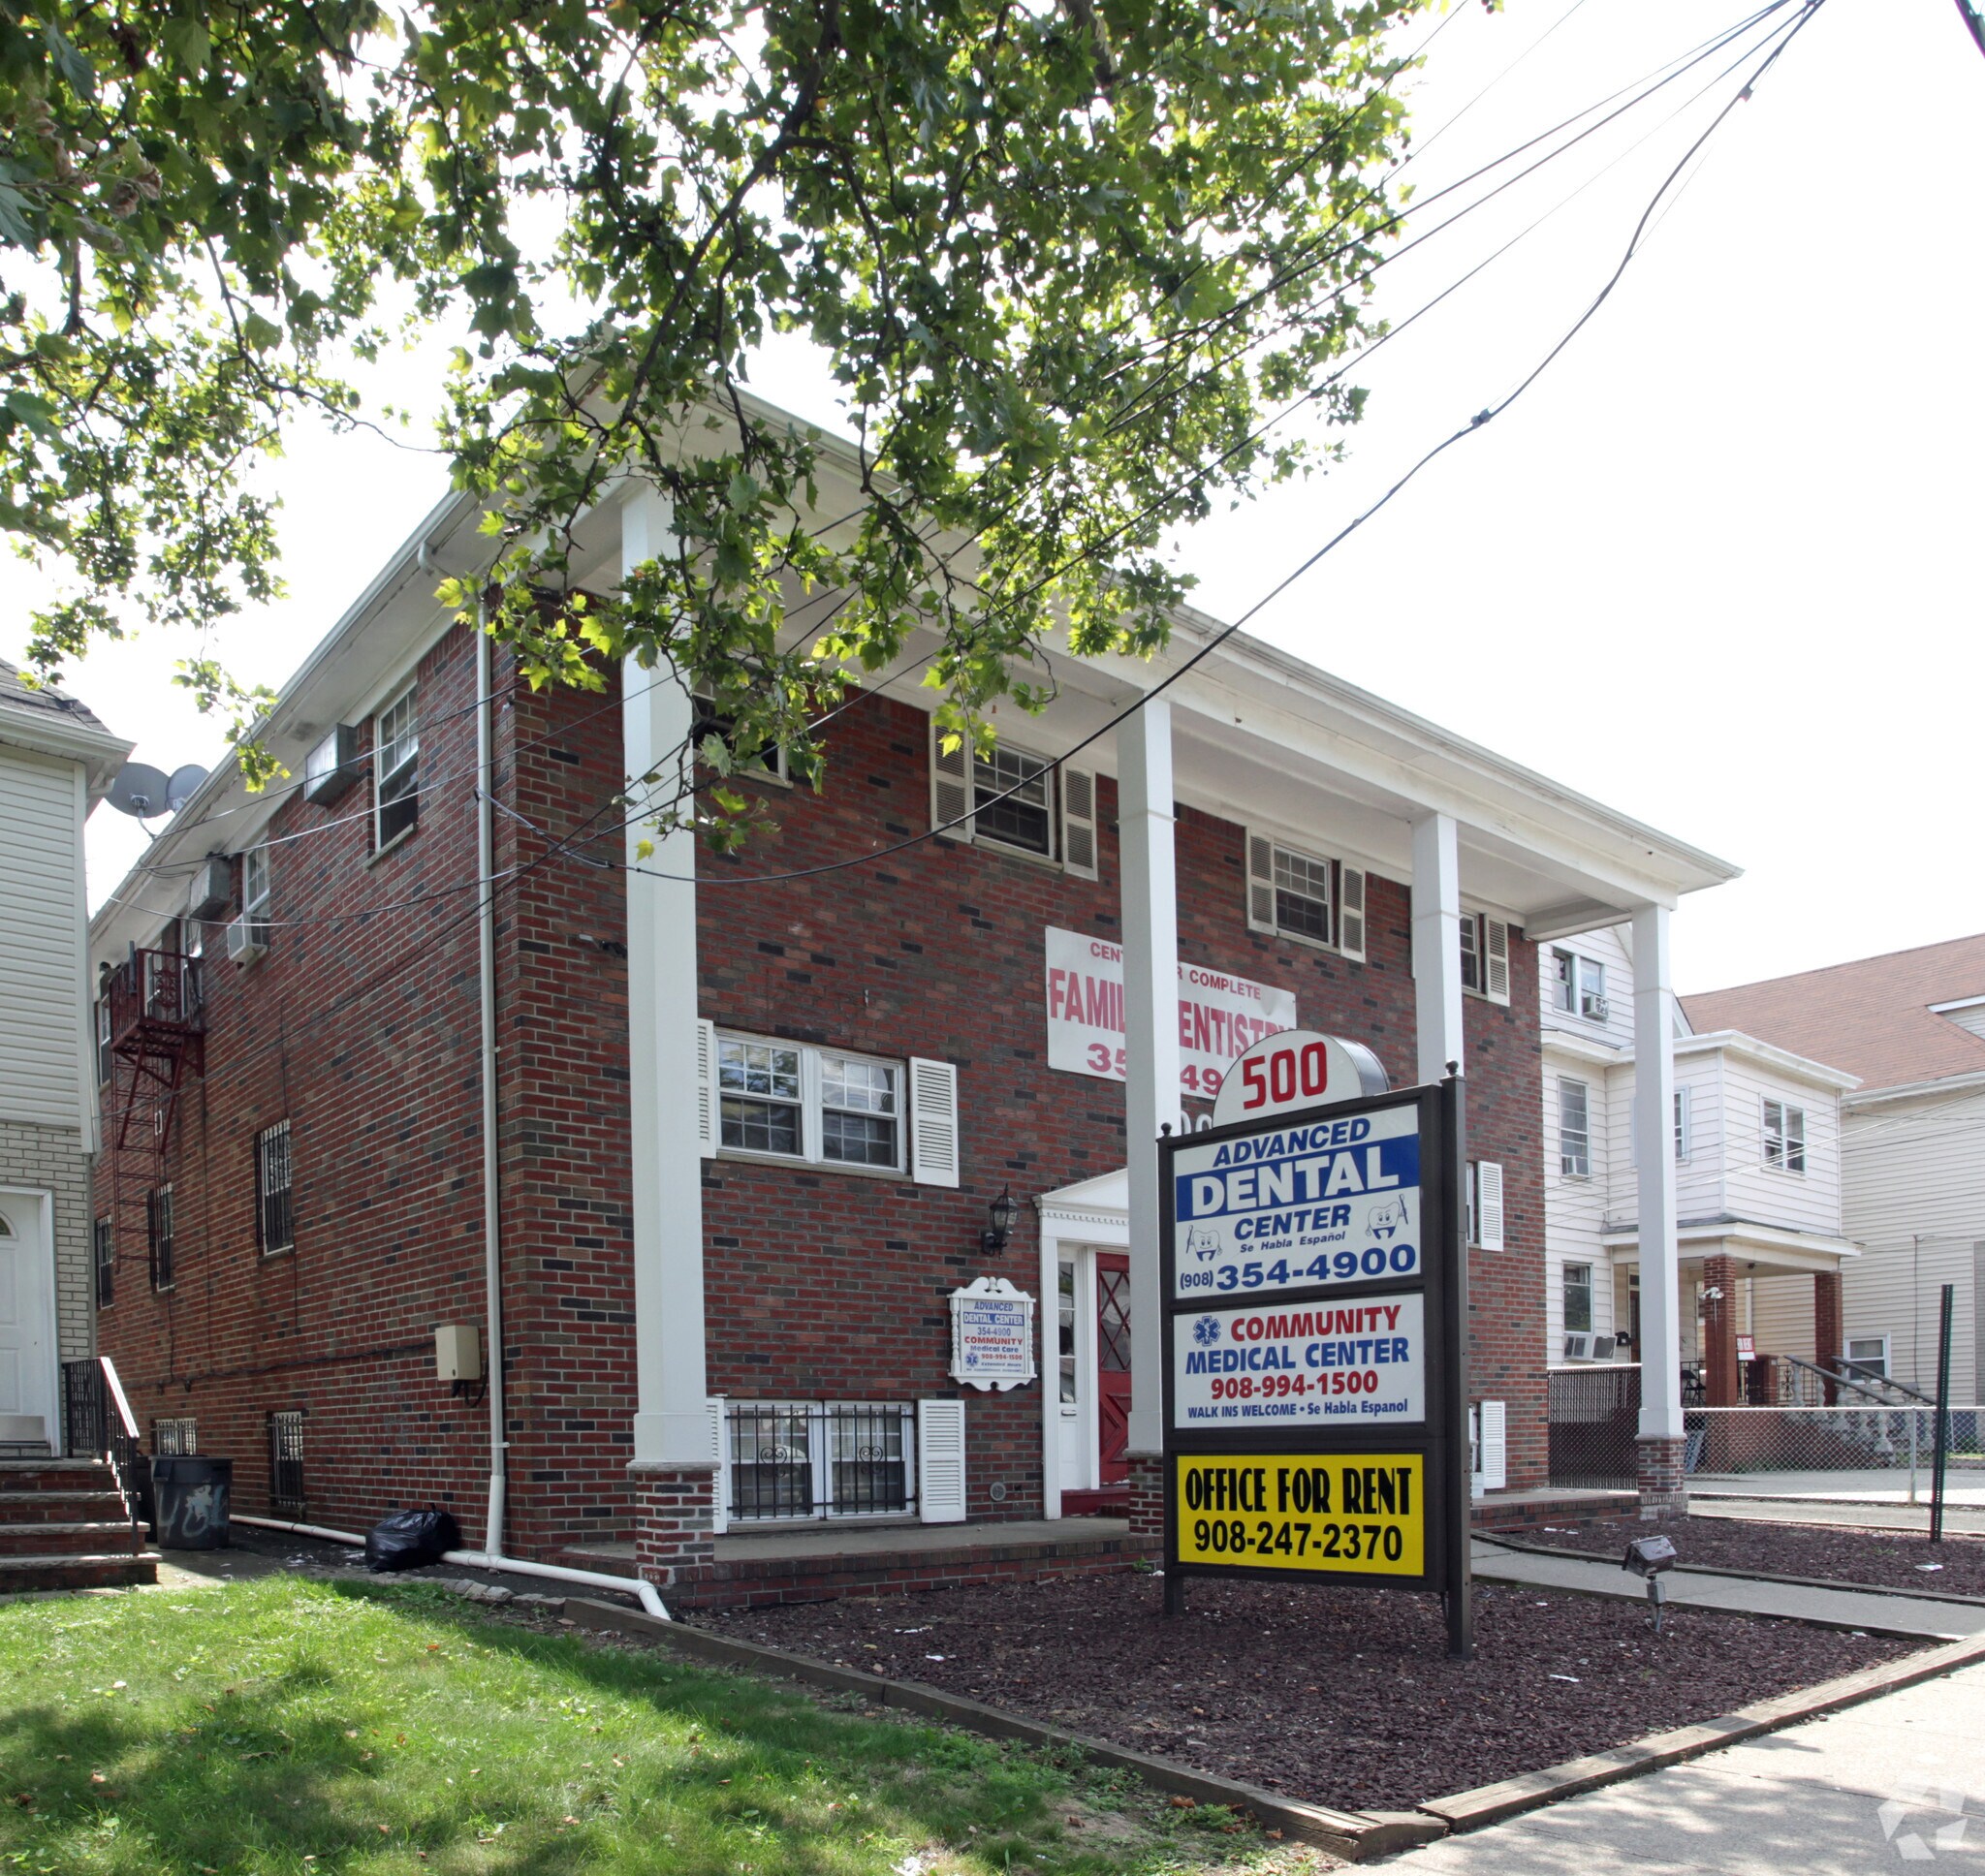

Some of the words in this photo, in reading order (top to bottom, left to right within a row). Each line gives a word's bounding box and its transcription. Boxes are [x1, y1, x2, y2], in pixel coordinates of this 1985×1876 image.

[1090, 942, 1123, 963] CEN
[1189, 969, 1262, 1000] COMPLETE
[1050, 967, 1124, 1034] FAMIL
[1243, 1041, 1327, 1110] 500
[1213, 1117, 1371, 1168] ADVANCED
[1191, 1145, 1400, 1217] DENTAL
[1234, 1204, 1351, 1240] CENTER
[1240, 1242, 1254, 1253] Se
[1261, 1236, 1292, 1250] Habla
[1299, 1231, 1345, 1247] Español
[1180, 1269, 1213, 1290] (908)
[1216, 1243, 1416, 1291] 354-4900
[964, 1313, 992, 1324] DENTAL
[994, 1314, 1023, 1325] CENTER
[974, 1301, 1014, 1311] ADVANCED
[1231, 1304, 1402, 1342] COMMUNITY
[964, 1336, 1023, 1345] COMMUNITY
[977, 1327, 1011, 1336] 354-4900
[1185, 1344, 1296, 1374] MEDICAL
[1305, 1337, 1409, 1368] CENTER
[1211, 1369, 1378, 1400] 908-994-1500
[1187, 1406, 1218, 1419] WALK
[1221, 1405, 1239, 1417] INS
[1242, 1403, 1297, 1417] WELCOME
[1308, 1403, 1321, 1415] Se
[1324, 1400, 1357, 1415] Habla
[1361, 1398, 1408, 1417] Espanol
[1185, 1467, 1267, 1512] OFFICE
[1277, 1467, 1332, 1514] FOR
[1342, 1467, 1411, 1515] RENT
[1194, 1519, 1402, 1561] 908-247-2370
